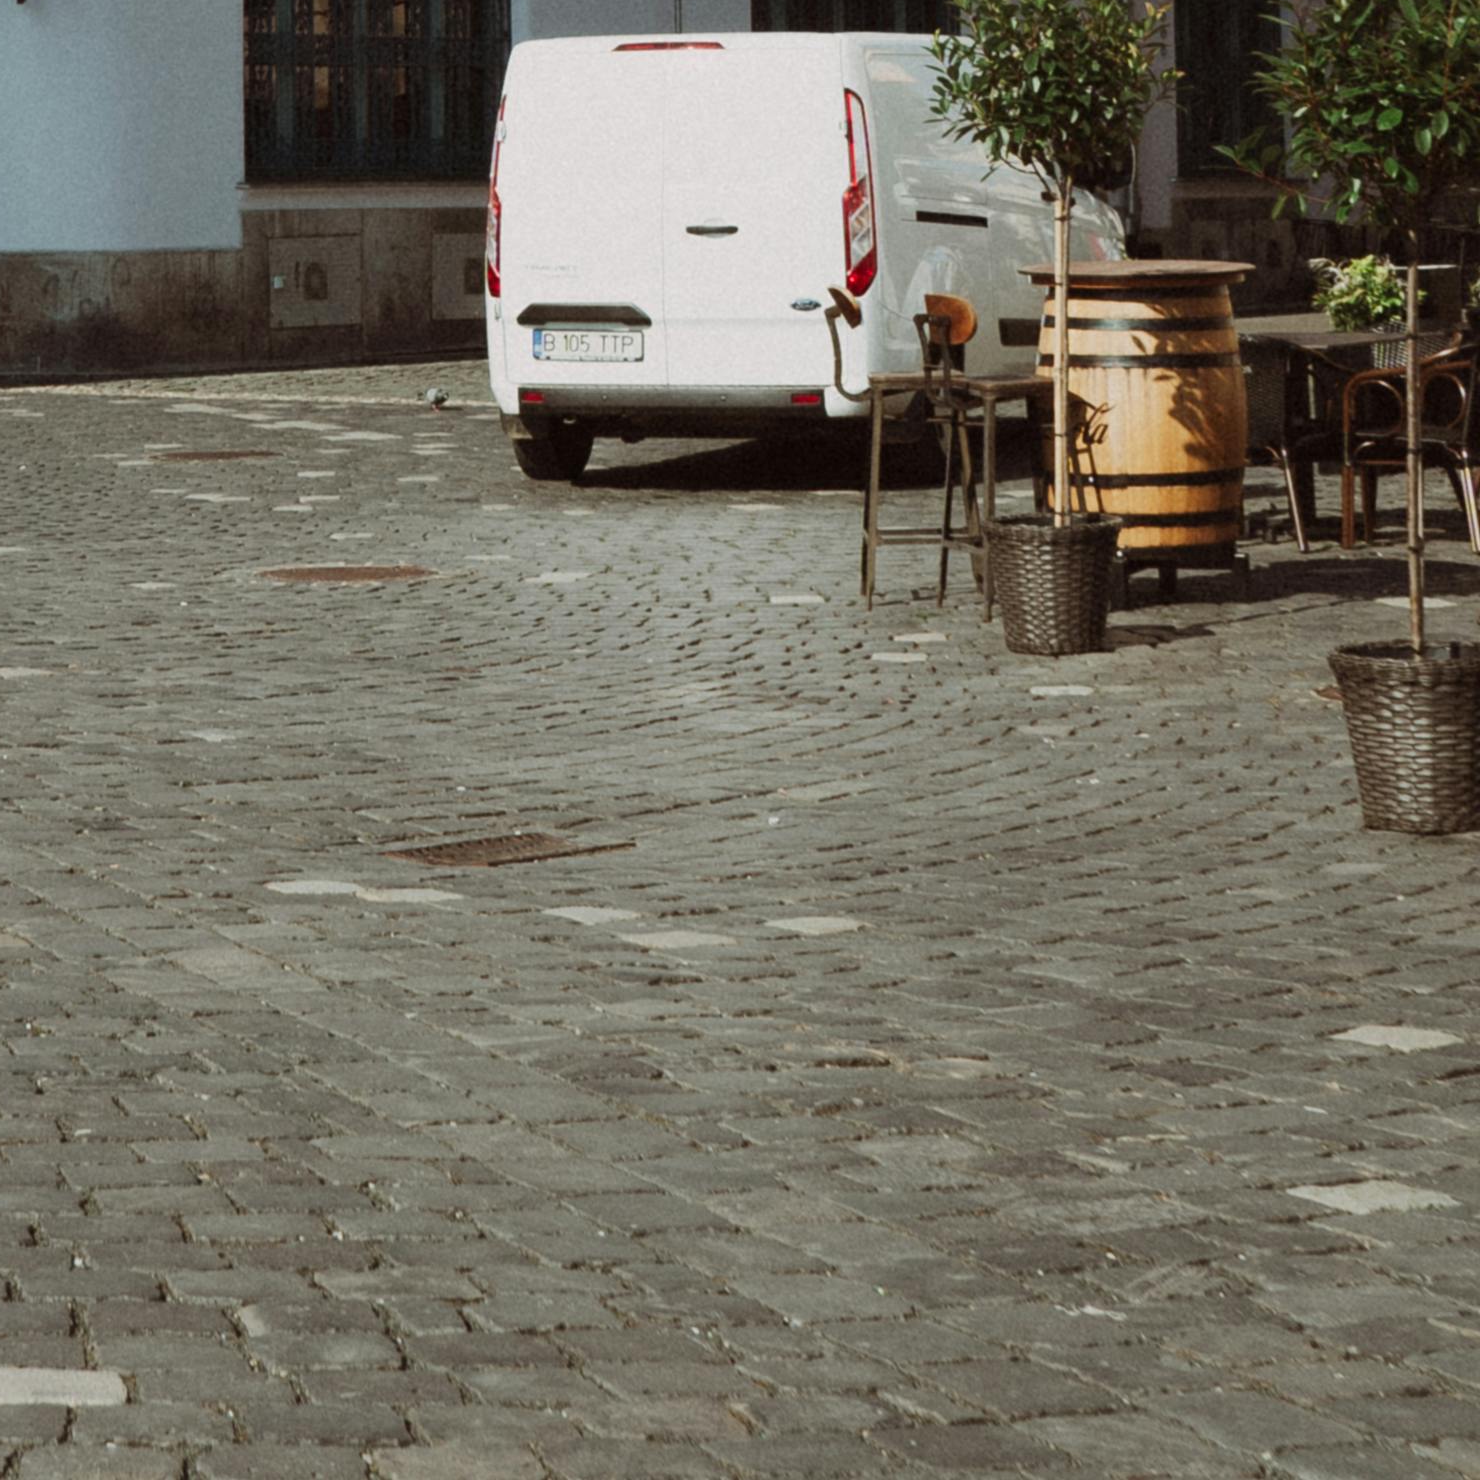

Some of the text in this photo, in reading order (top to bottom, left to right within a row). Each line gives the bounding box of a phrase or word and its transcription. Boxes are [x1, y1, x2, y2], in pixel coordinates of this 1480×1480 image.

[543, 333, 634, 353] B 105 TTP
